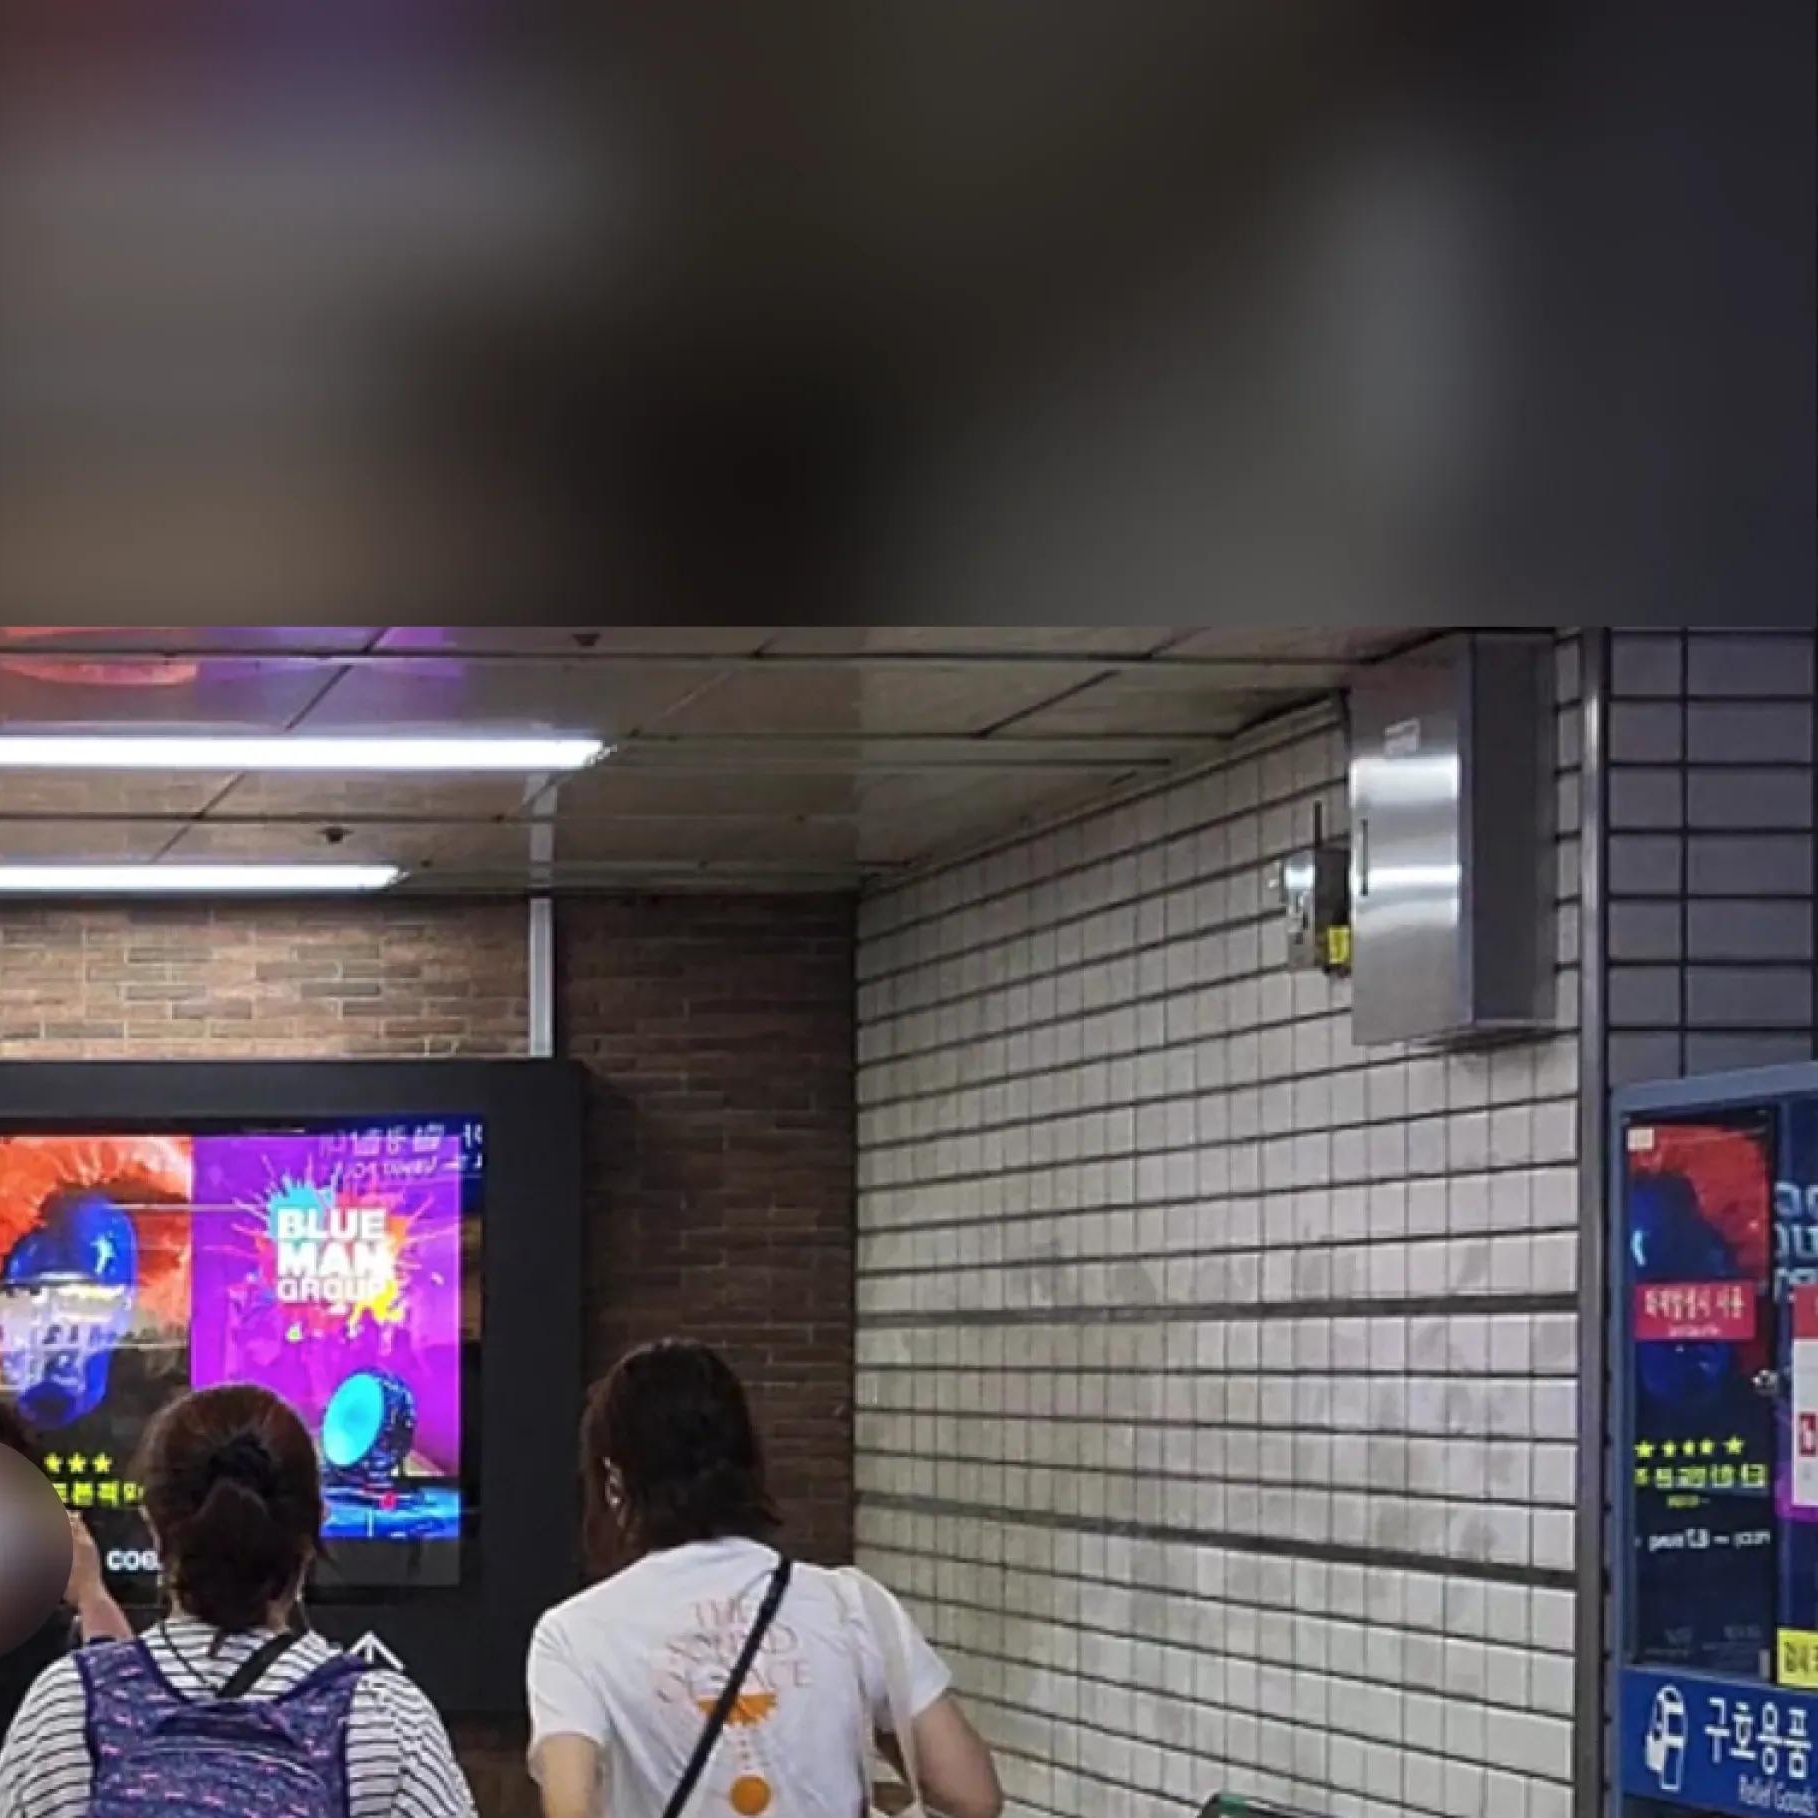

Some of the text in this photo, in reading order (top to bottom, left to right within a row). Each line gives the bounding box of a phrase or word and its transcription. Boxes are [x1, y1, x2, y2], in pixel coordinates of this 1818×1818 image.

[277, 1207, 387, 1239] BLUE
[277, 1241, 390, 1275] MAN
[277, 1277, 387, 1303] GROUP
[1703, 1696, 1813, 1780] 구호용품
